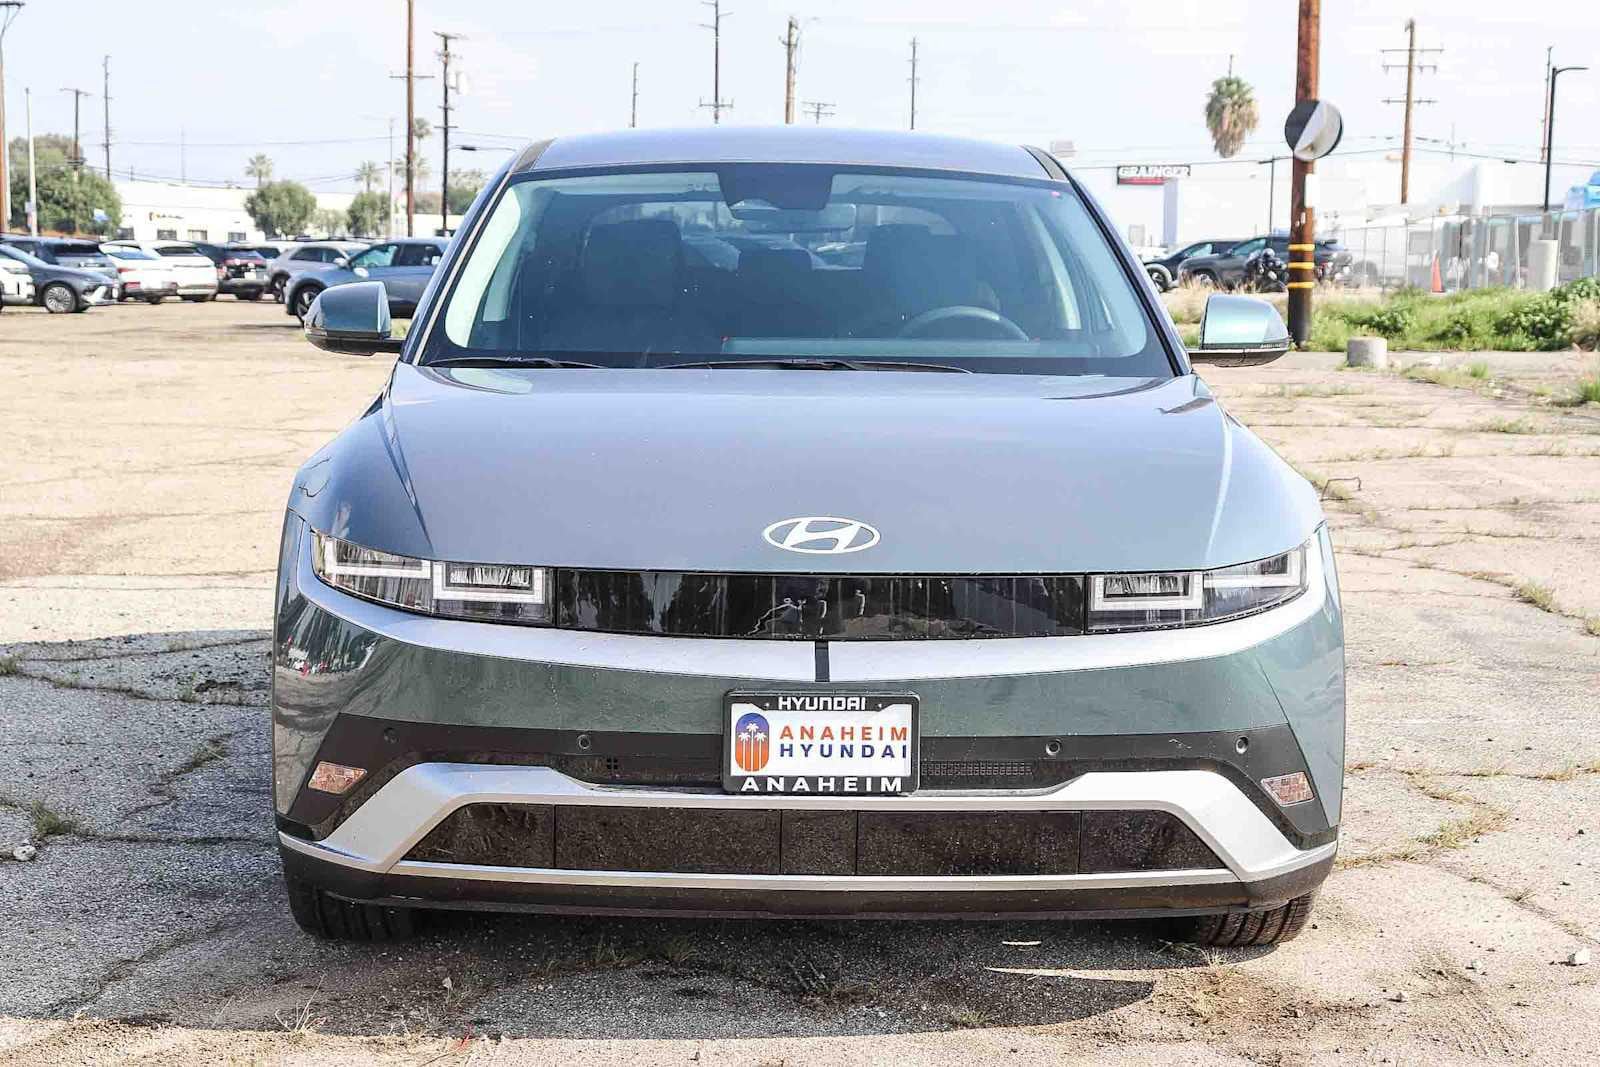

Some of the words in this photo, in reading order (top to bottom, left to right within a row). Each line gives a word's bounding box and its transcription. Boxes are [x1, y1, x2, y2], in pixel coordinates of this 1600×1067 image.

[1118, 166, 1190, 177] GRAINGER
[778, 696, 866, 711] HYUNDAI
[779, 725, 908, 741] ANAHEIM
[779, 743, 907, 758] HYUNDAI
[740, 776, 902, 792] ANAHEIM
